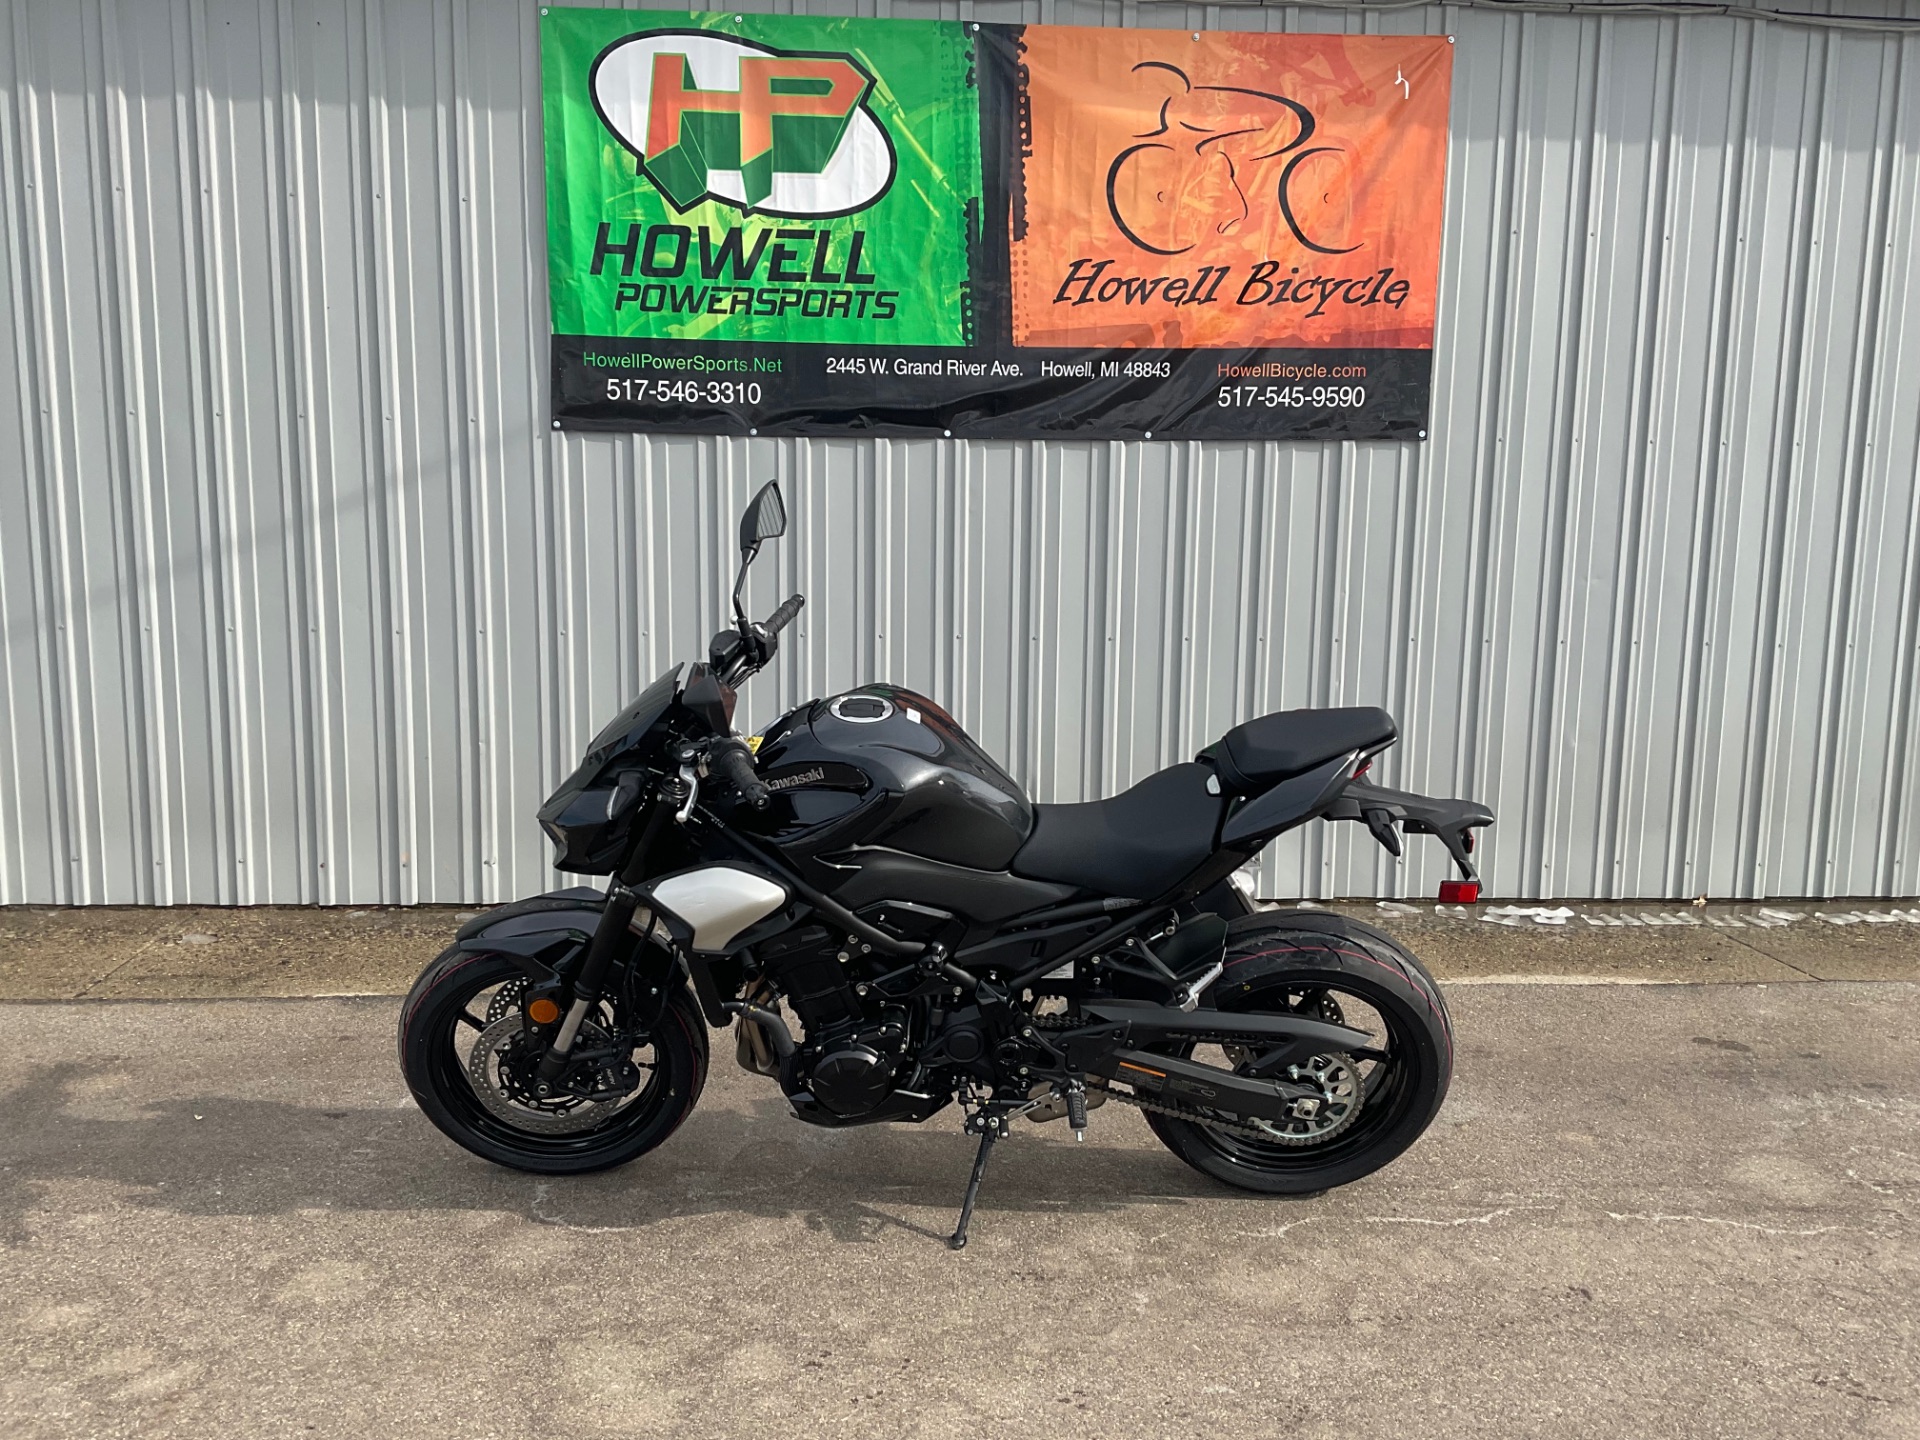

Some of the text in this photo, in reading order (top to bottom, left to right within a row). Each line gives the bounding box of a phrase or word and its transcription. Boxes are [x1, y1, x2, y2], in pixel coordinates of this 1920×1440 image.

[645, 53, 869, 207] HP
[589, 222, 876, 284] HOWELL
[614, 283, 899, 319] POWERSPORTS
[1052, 258, 1411, 318] Howell Bicycle
[583, 351, 783, 373] HowellPowerSports.Net
[826, 357, 1171, 379] 2445 W. Grand River Ave. Howell, MI 48843
[1217, 363, 1367, 381] HowellBicycle.com
[606, 378, 762, 404] 517-546-3310
[1217, 386, 1366, 408] 517-545-9590
